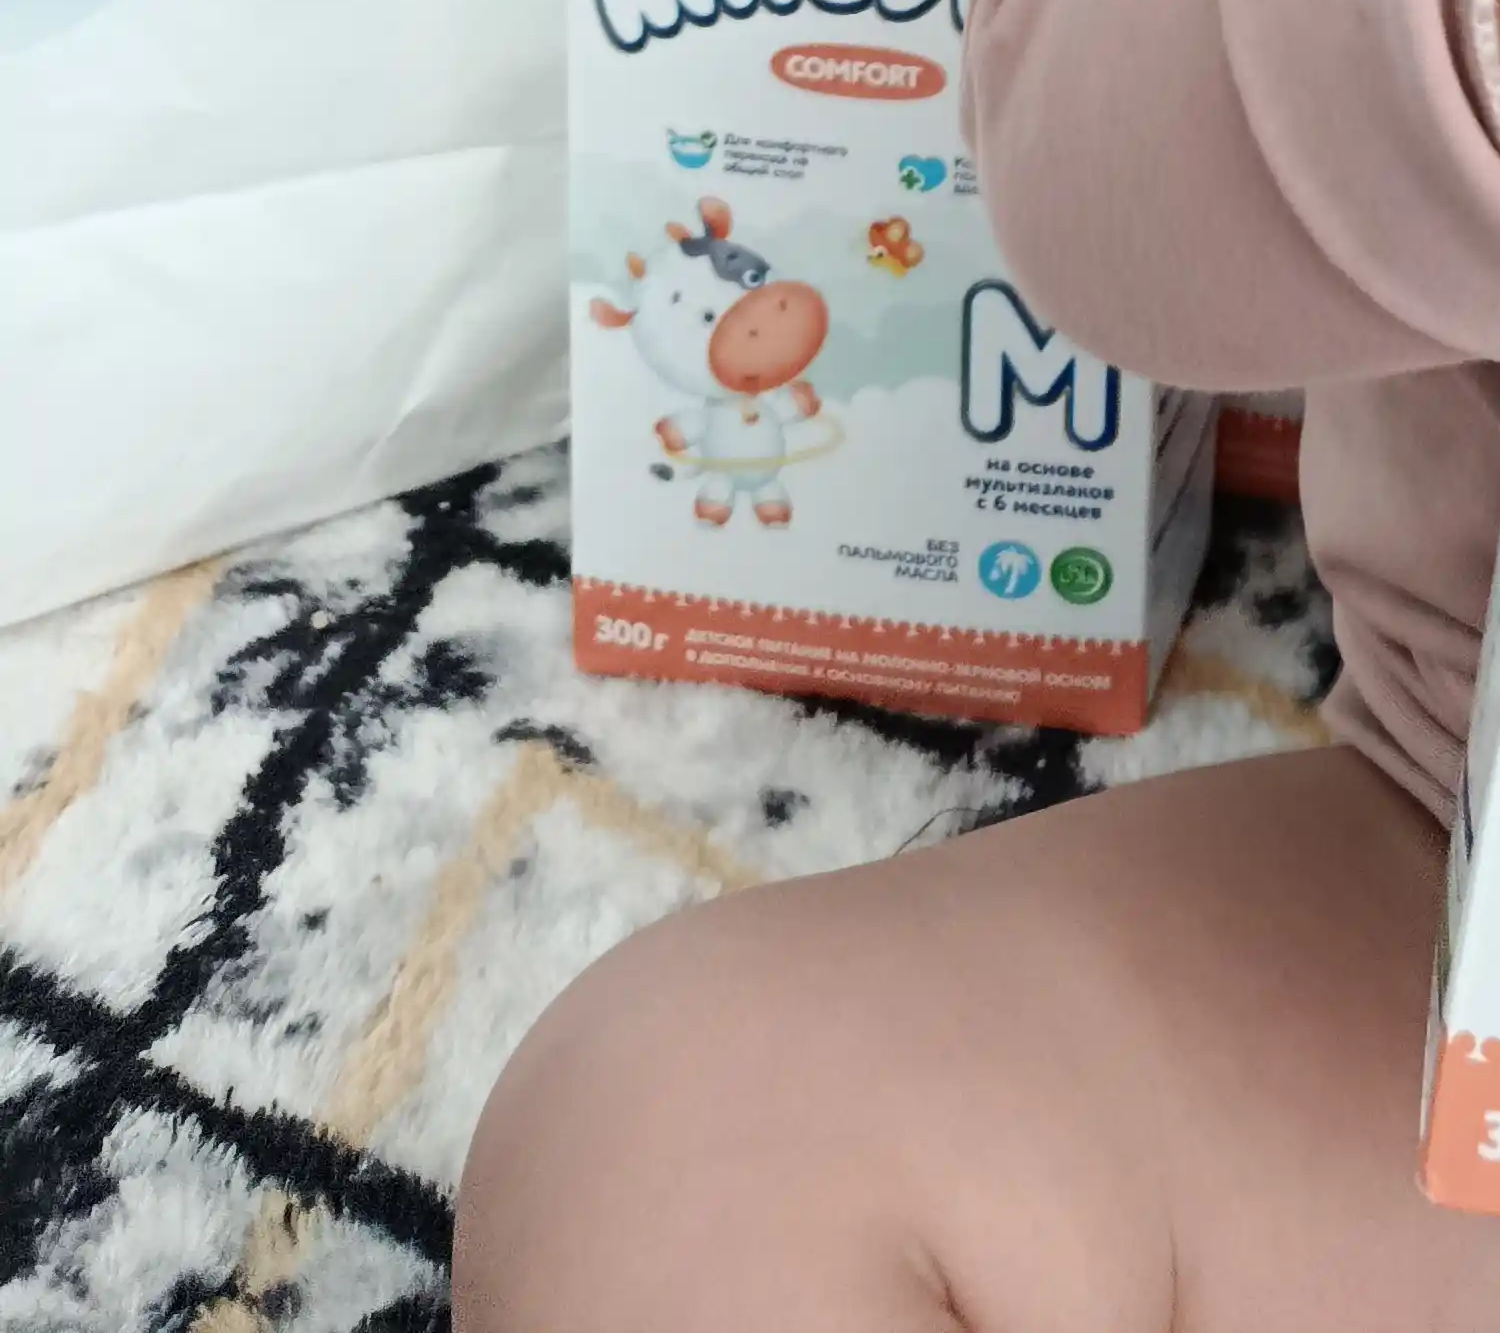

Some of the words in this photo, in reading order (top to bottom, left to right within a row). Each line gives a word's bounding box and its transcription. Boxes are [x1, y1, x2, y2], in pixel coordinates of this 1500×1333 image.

[784, 53, 925, 90] COMFORT
[986, 458, 1011, 472] на
[1017, 461, 1095, 480] основе
[965, 476, 1115, 501] мультизлаков
[976, 498, 987, 510] с
[993, 494, 1007, 511] 6
[1012, 500, 1103, 520] месяцев
[837, 544, 958, 568] ПАЛЬМОВОГО
[926, 538, 960, 553] БЕЗ
[894, 566, 958, 583] МАСЛА
